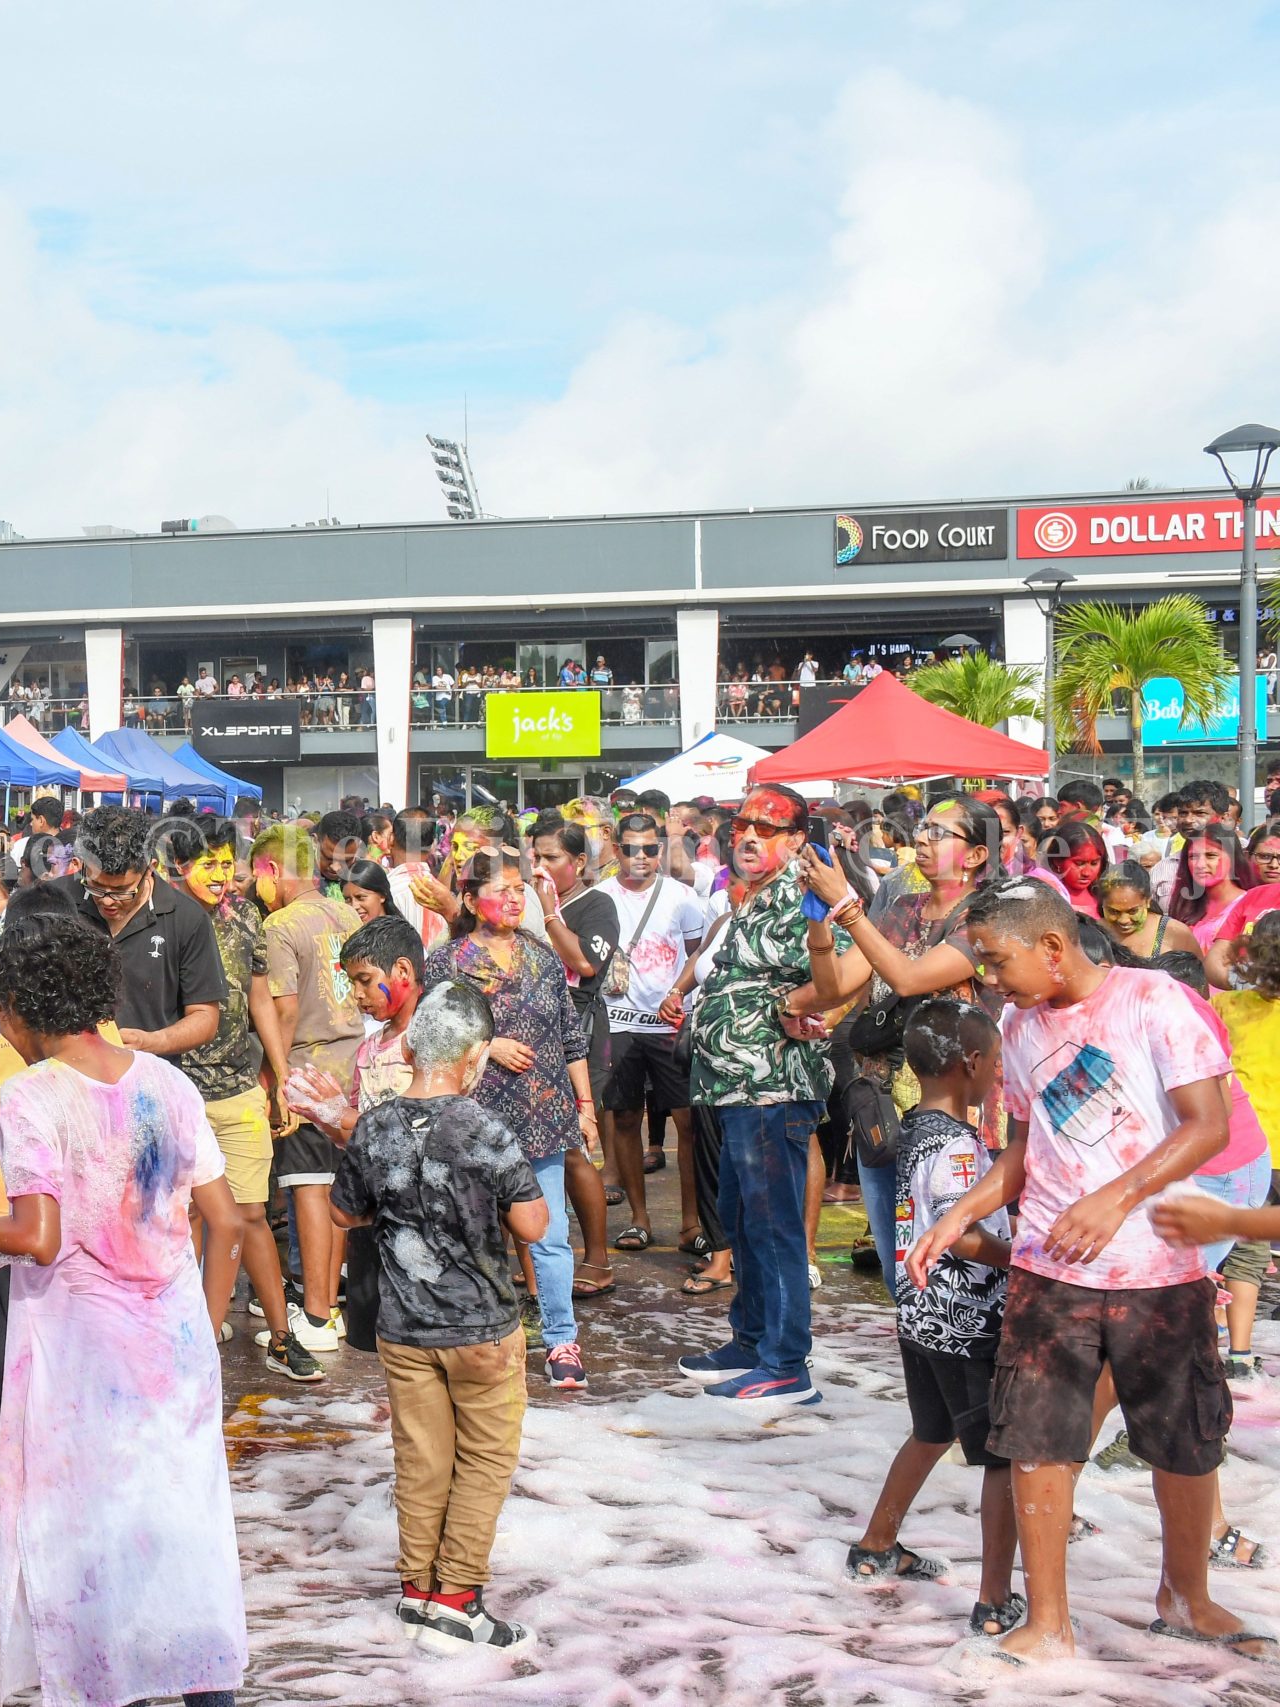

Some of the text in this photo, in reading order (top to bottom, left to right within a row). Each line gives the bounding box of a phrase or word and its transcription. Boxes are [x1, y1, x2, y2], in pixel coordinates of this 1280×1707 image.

[872, 523, 996, 550] FOOD COURT
[1090, 513, 1206, 544] DOLLAR
[200, 725, 293, 737] XLSPORTS
[512, 706, 574, 744] jack's
[590, 935, 611, 961] 35
[609, 1009, 637, 1023] STAY
